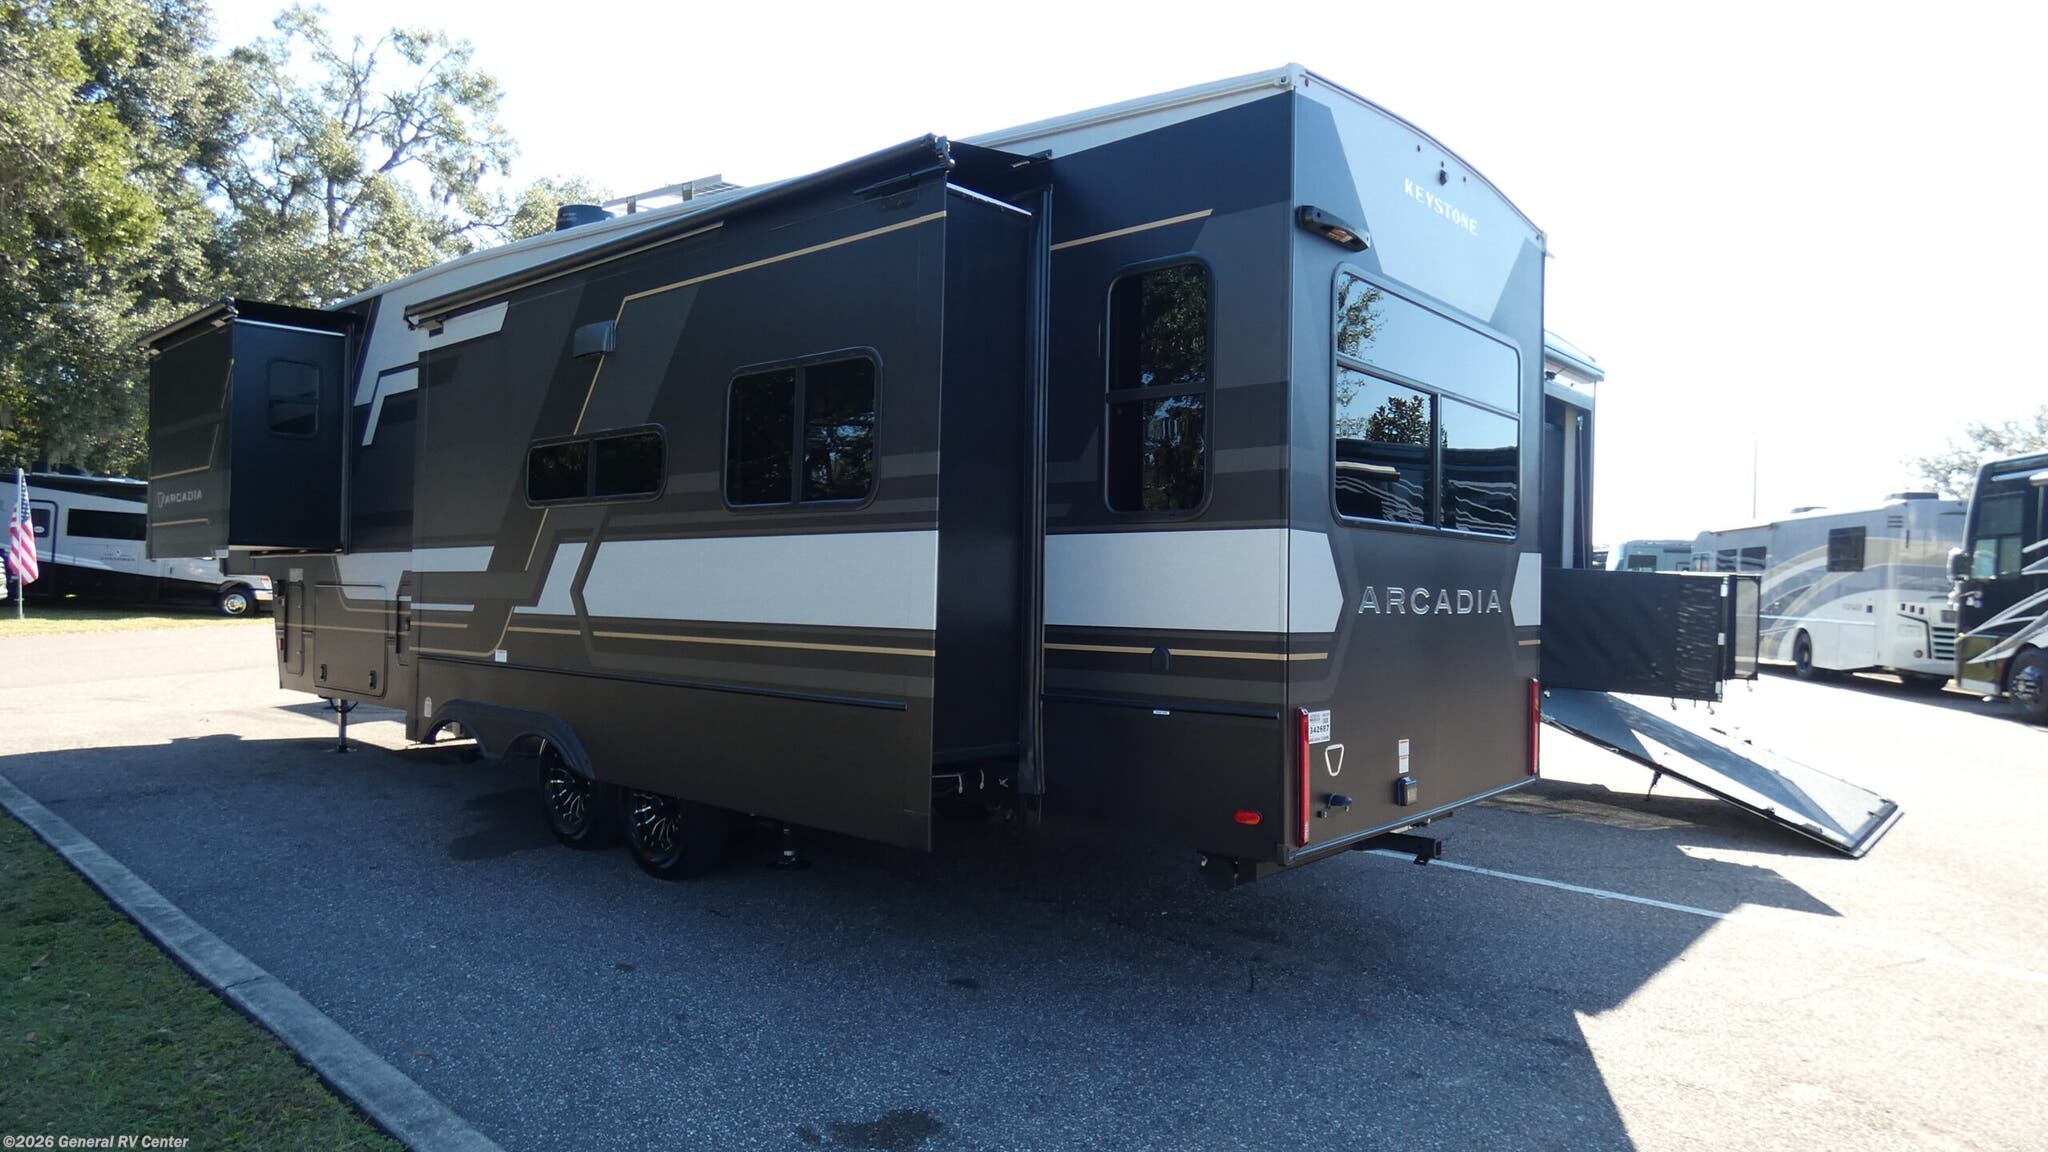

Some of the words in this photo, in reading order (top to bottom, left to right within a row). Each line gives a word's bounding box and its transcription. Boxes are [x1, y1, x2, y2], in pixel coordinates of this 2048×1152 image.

[1403, 178, 1479, 236] KEYSTONE
[165, 490, 203, 505] ARCADIA
[1358, 585, 1503, 615] ARCADIA
